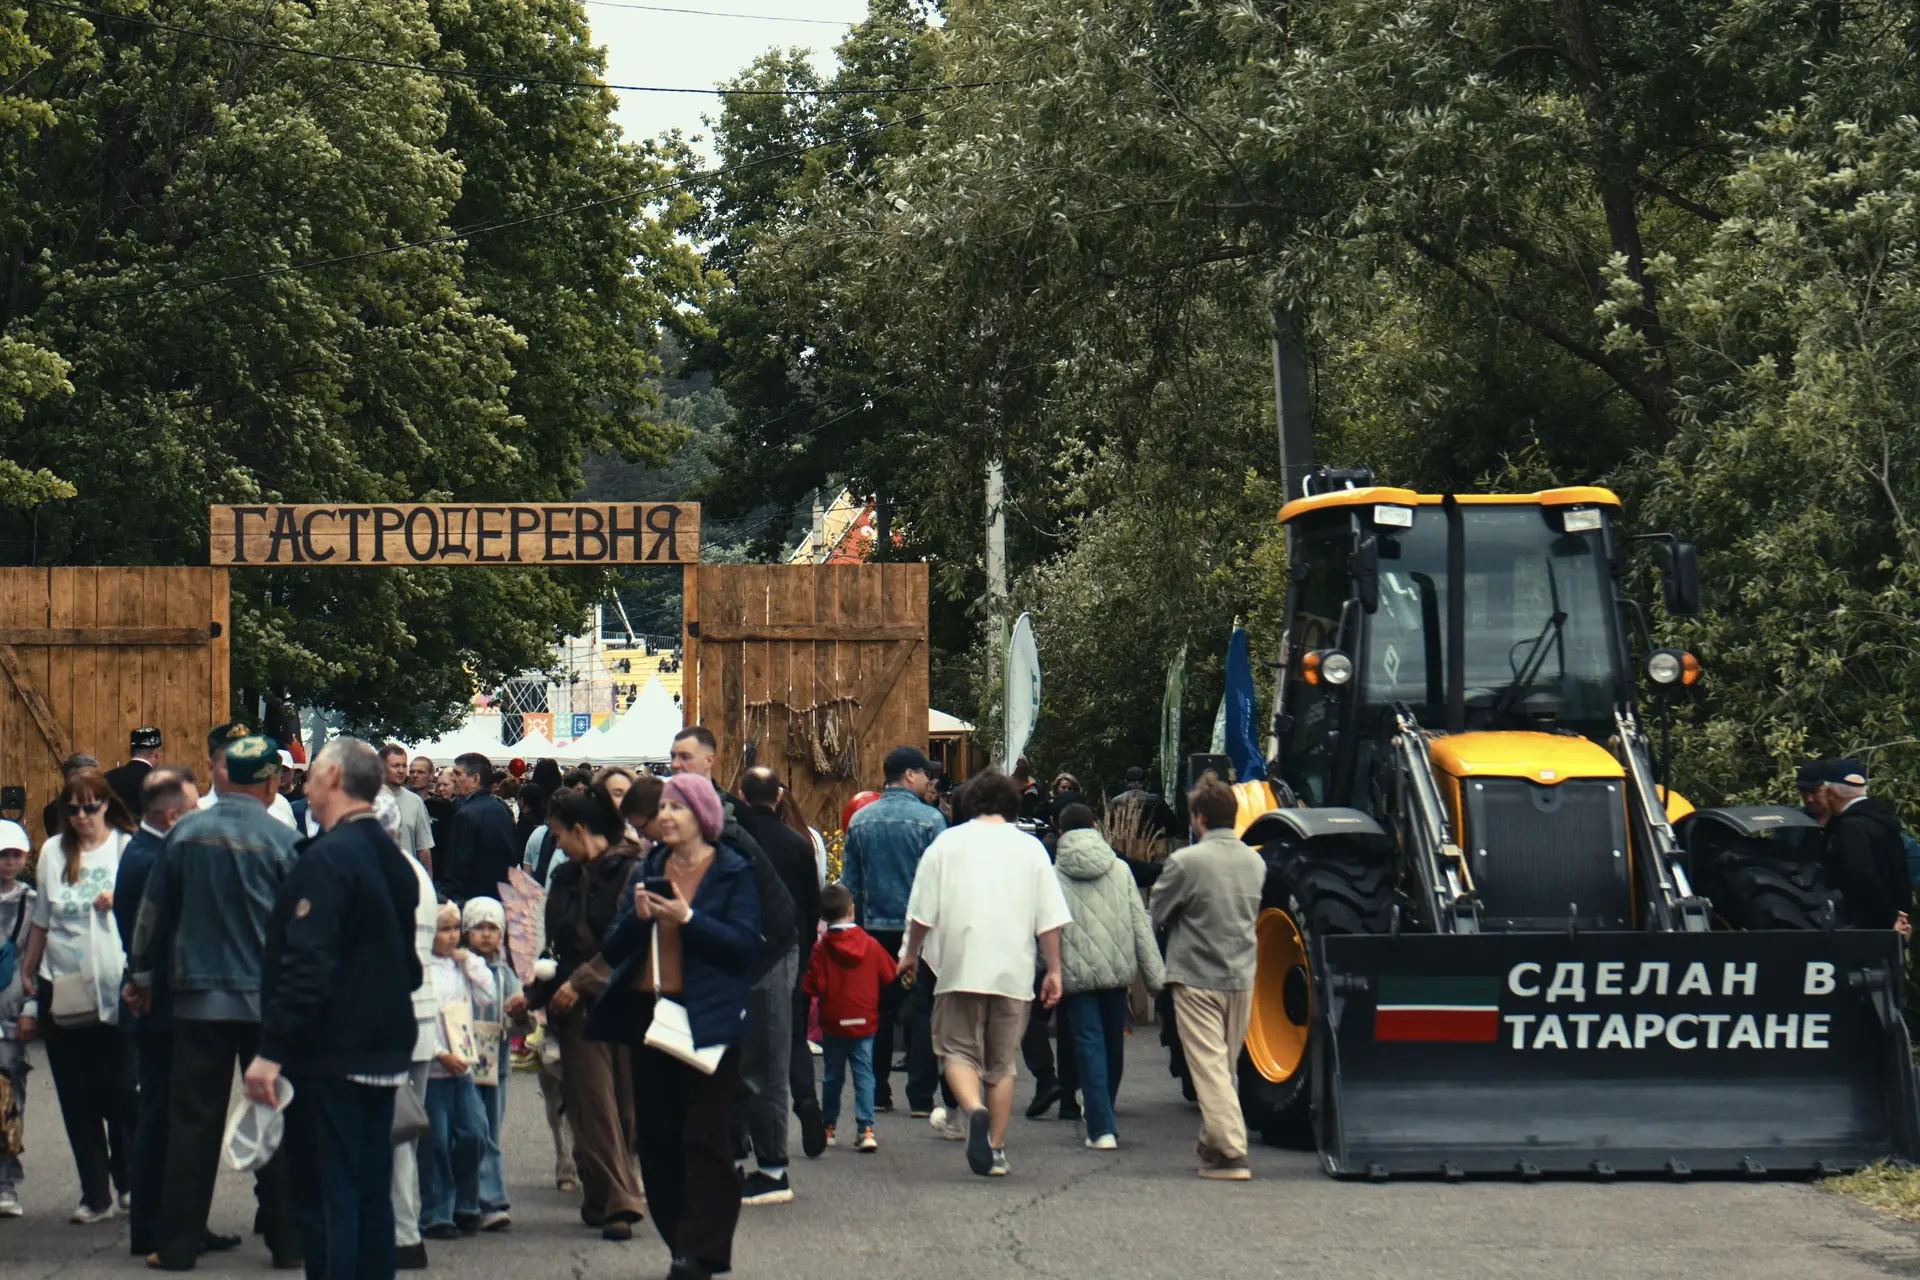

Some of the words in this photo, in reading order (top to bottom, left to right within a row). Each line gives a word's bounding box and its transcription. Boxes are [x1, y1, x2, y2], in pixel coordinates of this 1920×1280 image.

[232, 505, 683, 562] ГАСТРОДЕРЕВНЯ
[1508, 963, 1757, 1002] СДЕЛАН
[1803, 961, 1836, 995] В
[1503, 1013, 1831, 1050] ТАТАРСТАНЕ
